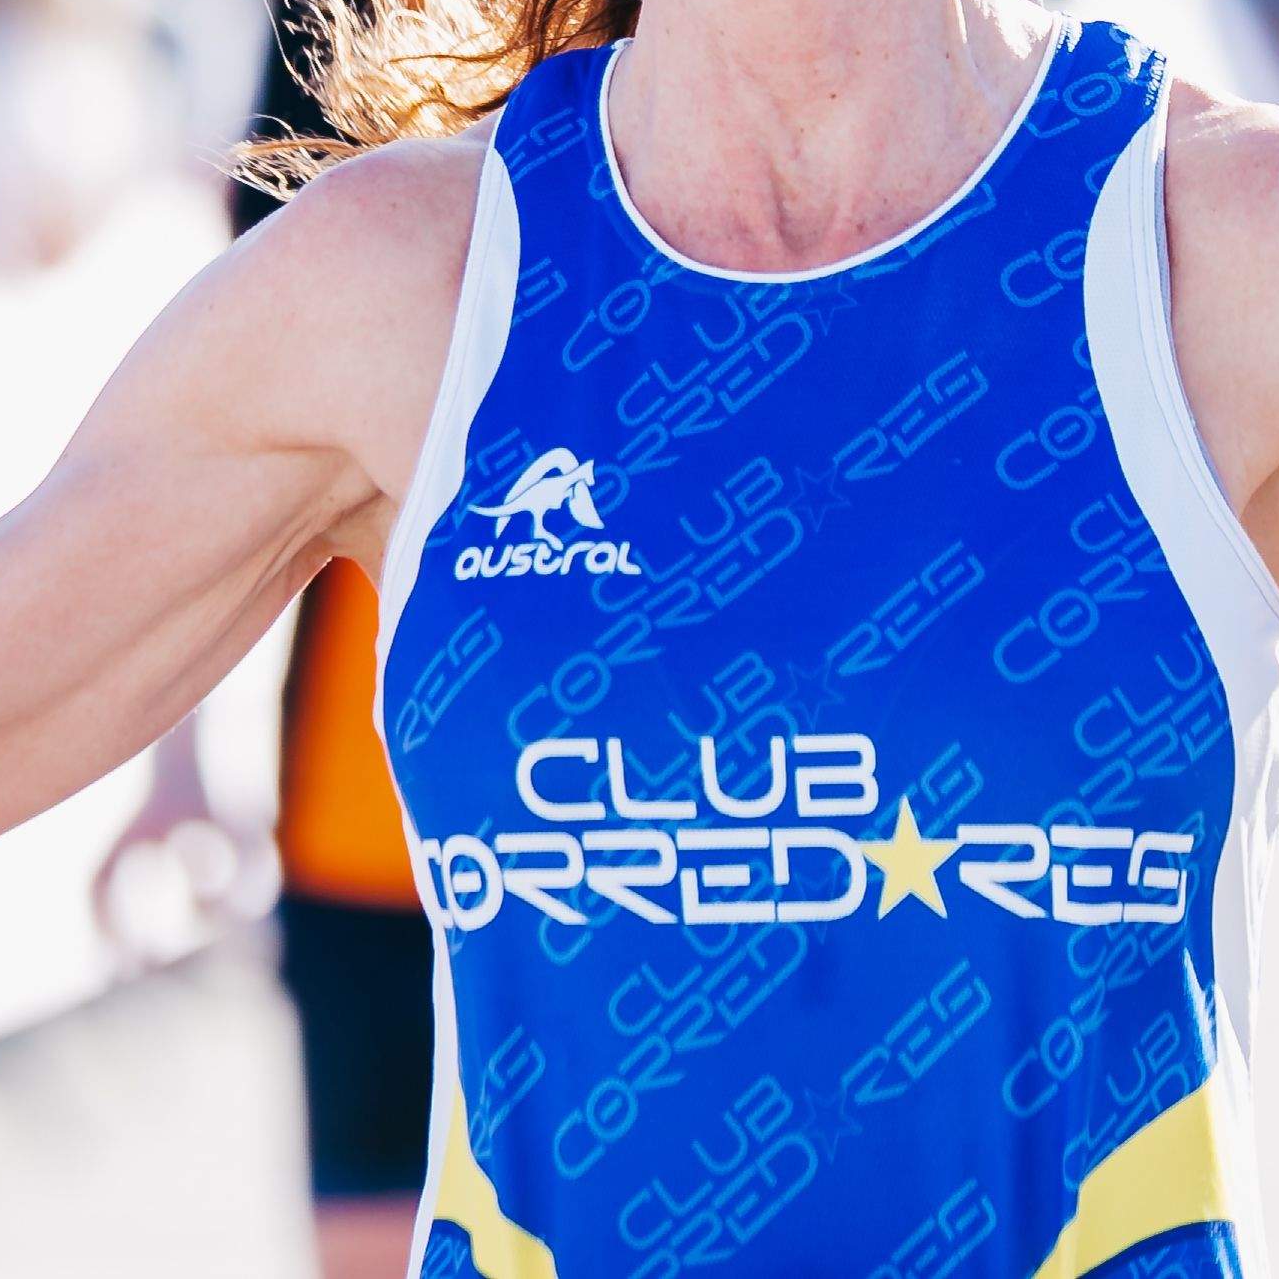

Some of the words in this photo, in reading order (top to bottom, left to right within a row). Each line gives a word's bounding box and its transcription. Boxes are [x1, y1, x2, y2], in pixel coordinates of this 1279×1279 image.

[833, 348, 991, 481] RES
[590, 454, 785, 614] CLUB
[824, 539, 987, 677] RES
[515, 733, 879, 822] CLUB
[553, 920, 808, 1181] CORRED
[840, 956, 993, 1105] RES
[618, 1073, 794, 1251] CLUB
[868, 1176, 997, 1279] ES
